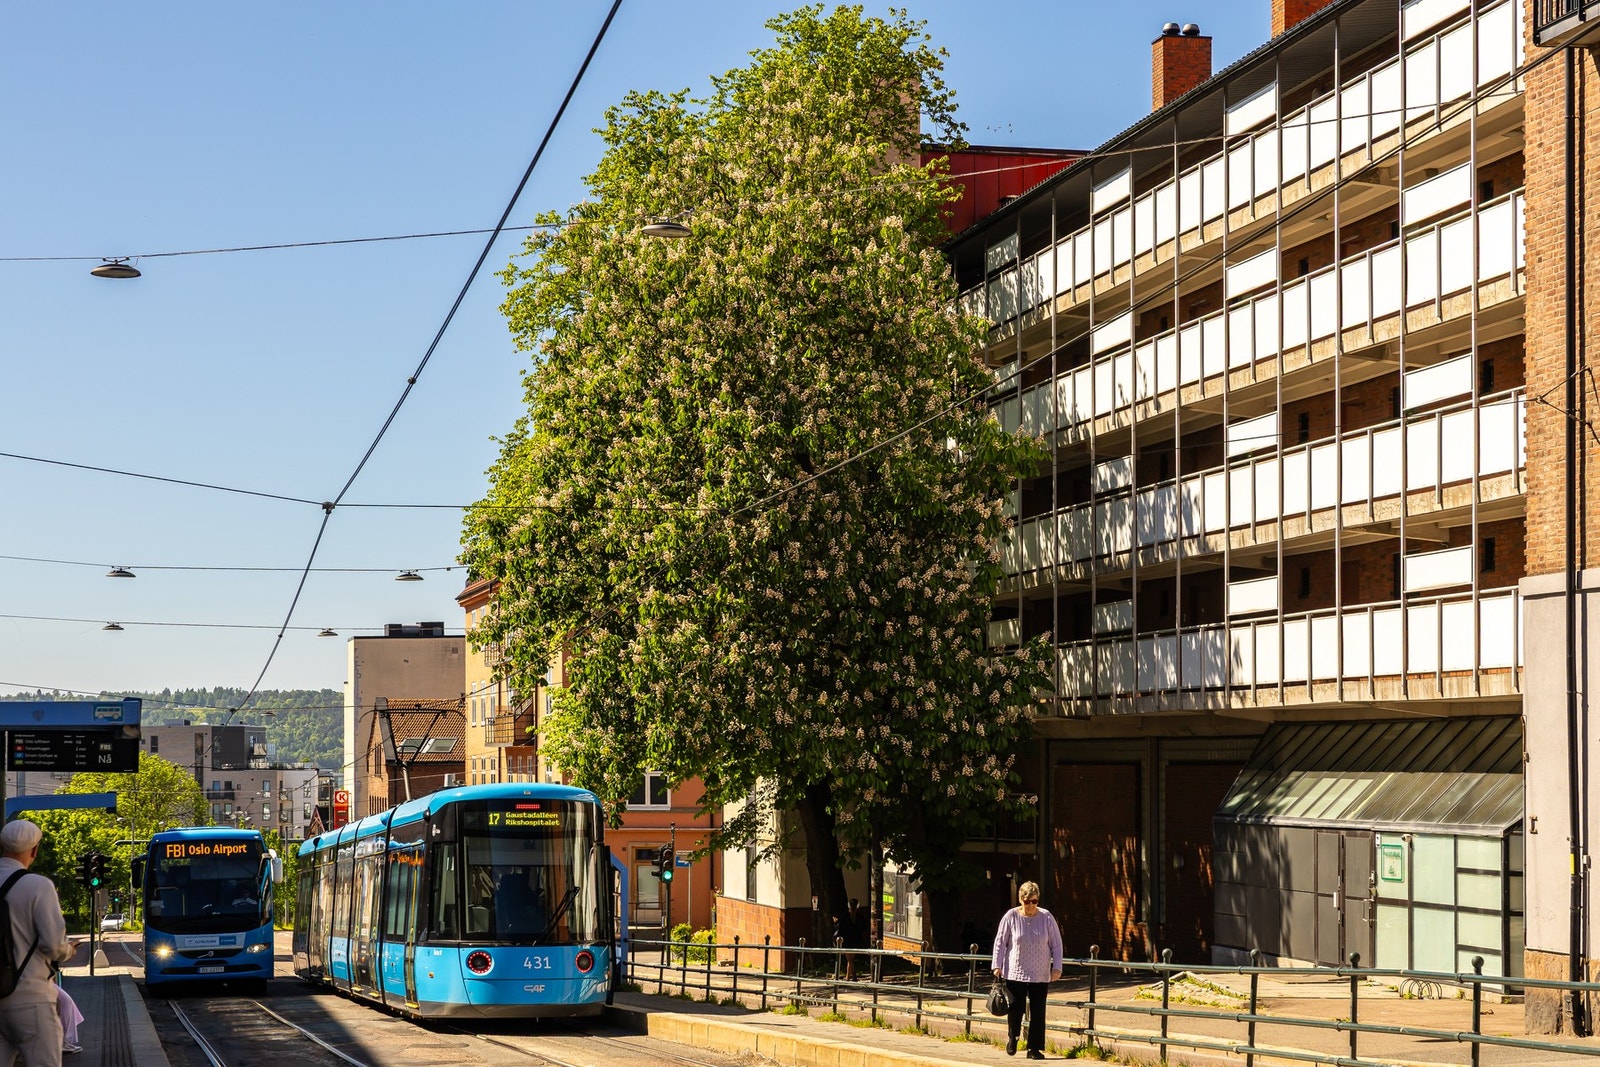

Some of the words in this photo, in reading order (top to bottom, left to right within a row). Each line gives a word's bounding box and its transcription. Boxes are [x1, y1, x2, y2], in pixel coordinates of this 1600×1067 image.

[98, 754, 112, 764] Nå
[488, 813, 500, 825] 17
[166, 844, 186, 858] FB1
[188, 843, 211, 855] Oslo
[213, 844, 247, 856] Airport
[523, 956, 552, 970] 431
[523, 984, 546, 993] CAF
